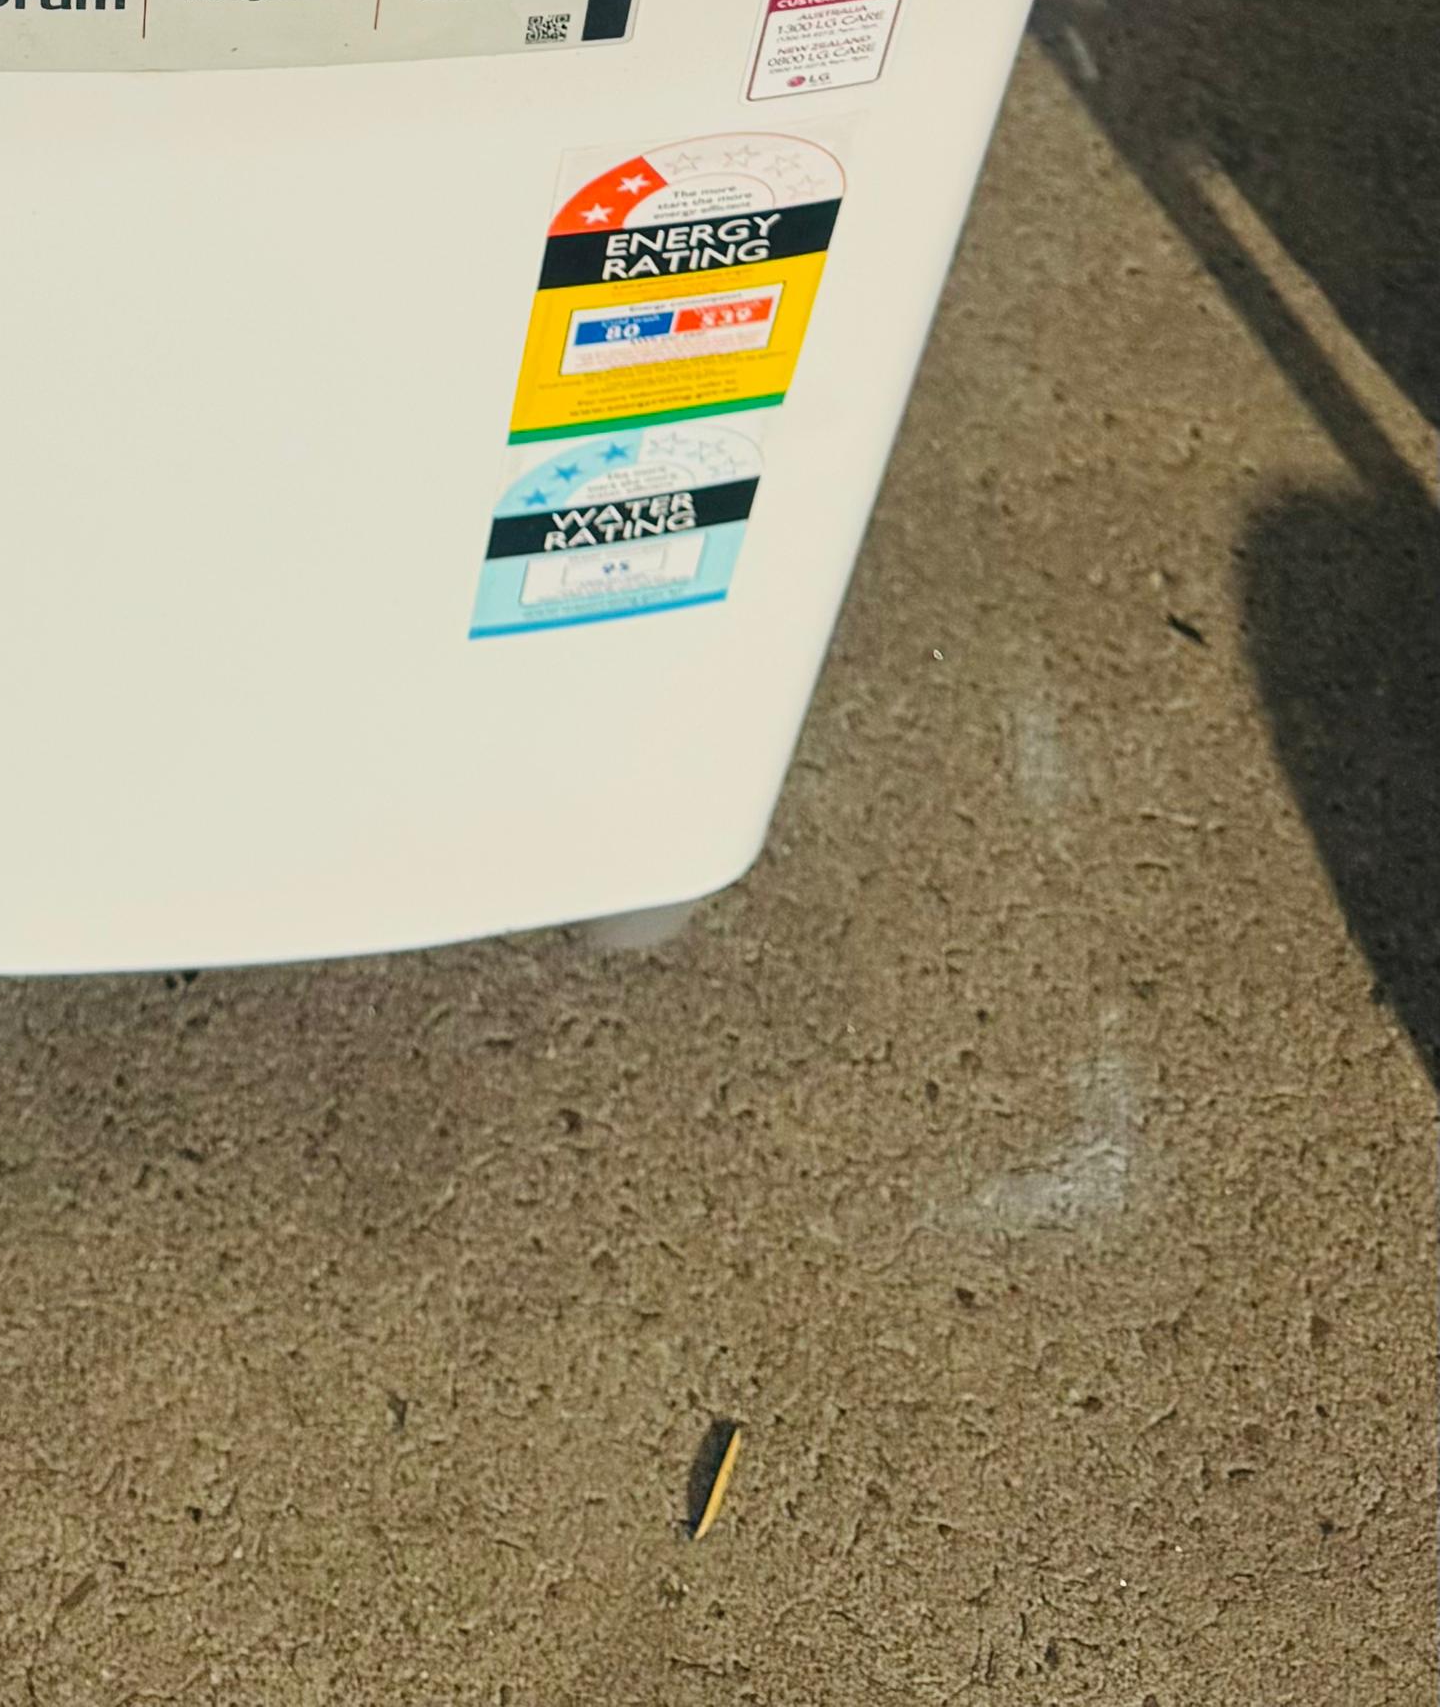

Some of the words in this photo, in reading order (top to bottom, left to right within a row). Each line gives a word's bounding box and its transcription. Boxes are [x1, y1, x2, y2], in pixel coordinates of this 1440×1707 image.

[606, 213, 782, 257] ENERGY
[602, 239, 770, 281] RATING
[543, 510, 697, 552] RATING
[551, 491, 695, 531] WATER
